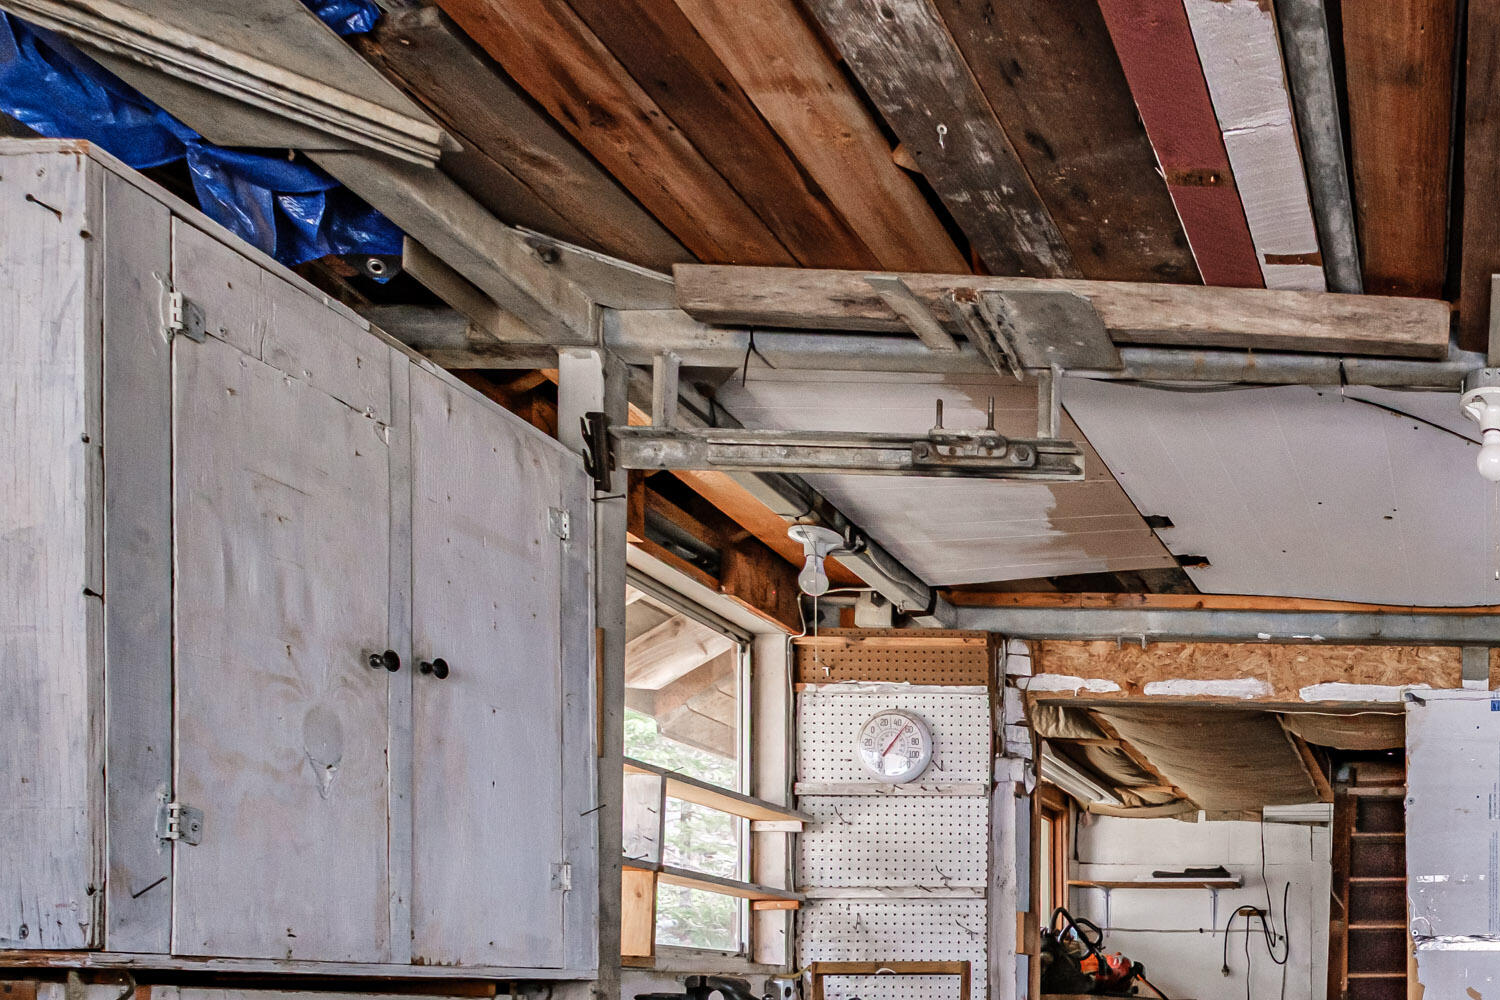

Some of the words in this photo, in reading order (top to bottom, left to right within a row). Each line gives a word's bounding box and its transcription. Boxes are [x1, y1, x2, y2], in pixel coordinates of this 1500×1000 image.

[880, 718, 888, 726] 20
[894, 718, 902, 726] 40
[871, 725, 875, 734] 0
[911, 738, 919, 746] 80
[909, 750, 919, 758] 100
